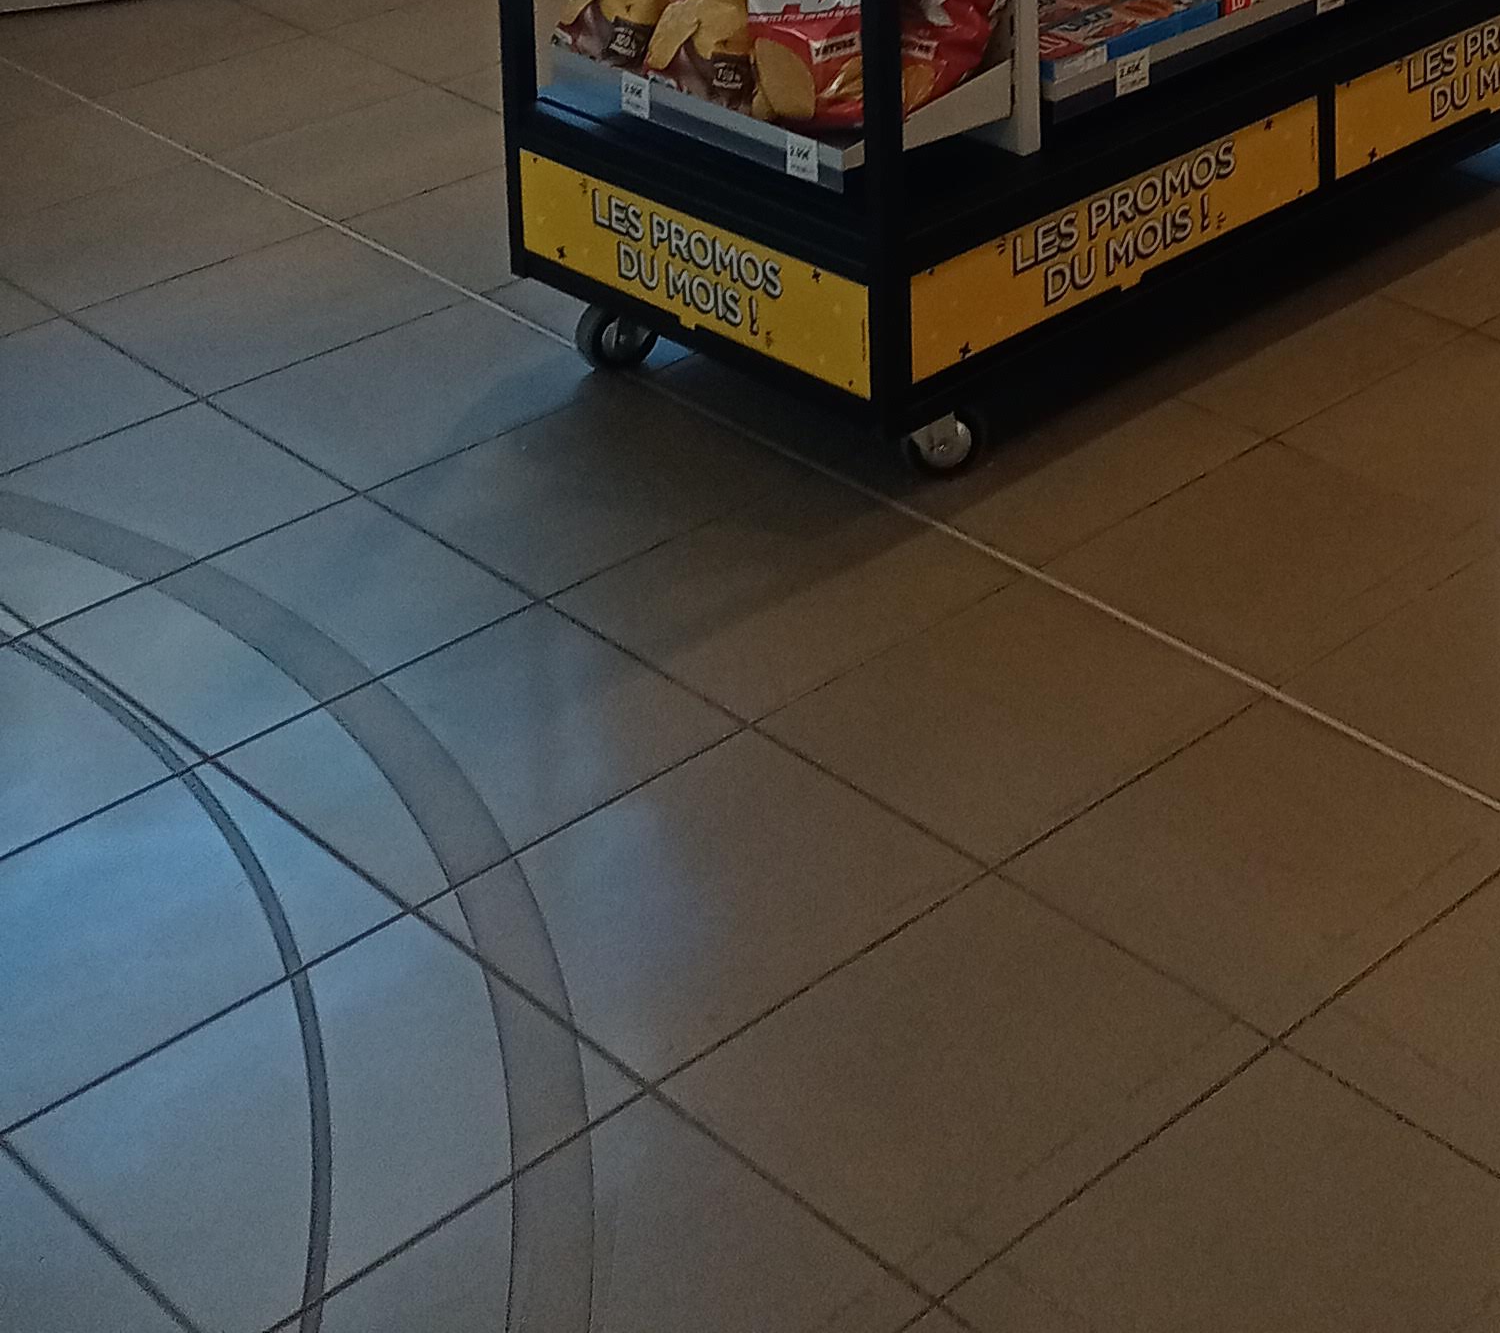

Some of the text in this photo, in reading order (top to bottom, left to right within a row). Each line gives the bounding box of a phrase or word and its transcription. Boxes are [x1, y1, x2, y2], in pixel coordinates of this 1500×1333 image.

[1408, 41, 1457, 93] LES
[1431, 72, 1470, 121] DU
[592, 188, 784, 299] LES PROMOS
[1013, 140, 1236, 275] LES PROMOS
[618, 241, 660, 290] DU
[665, 260, 743, 327] MOIS
[1044, 247, 1096, 307] DU
[1105, 204, 1193, 277] MOIS
